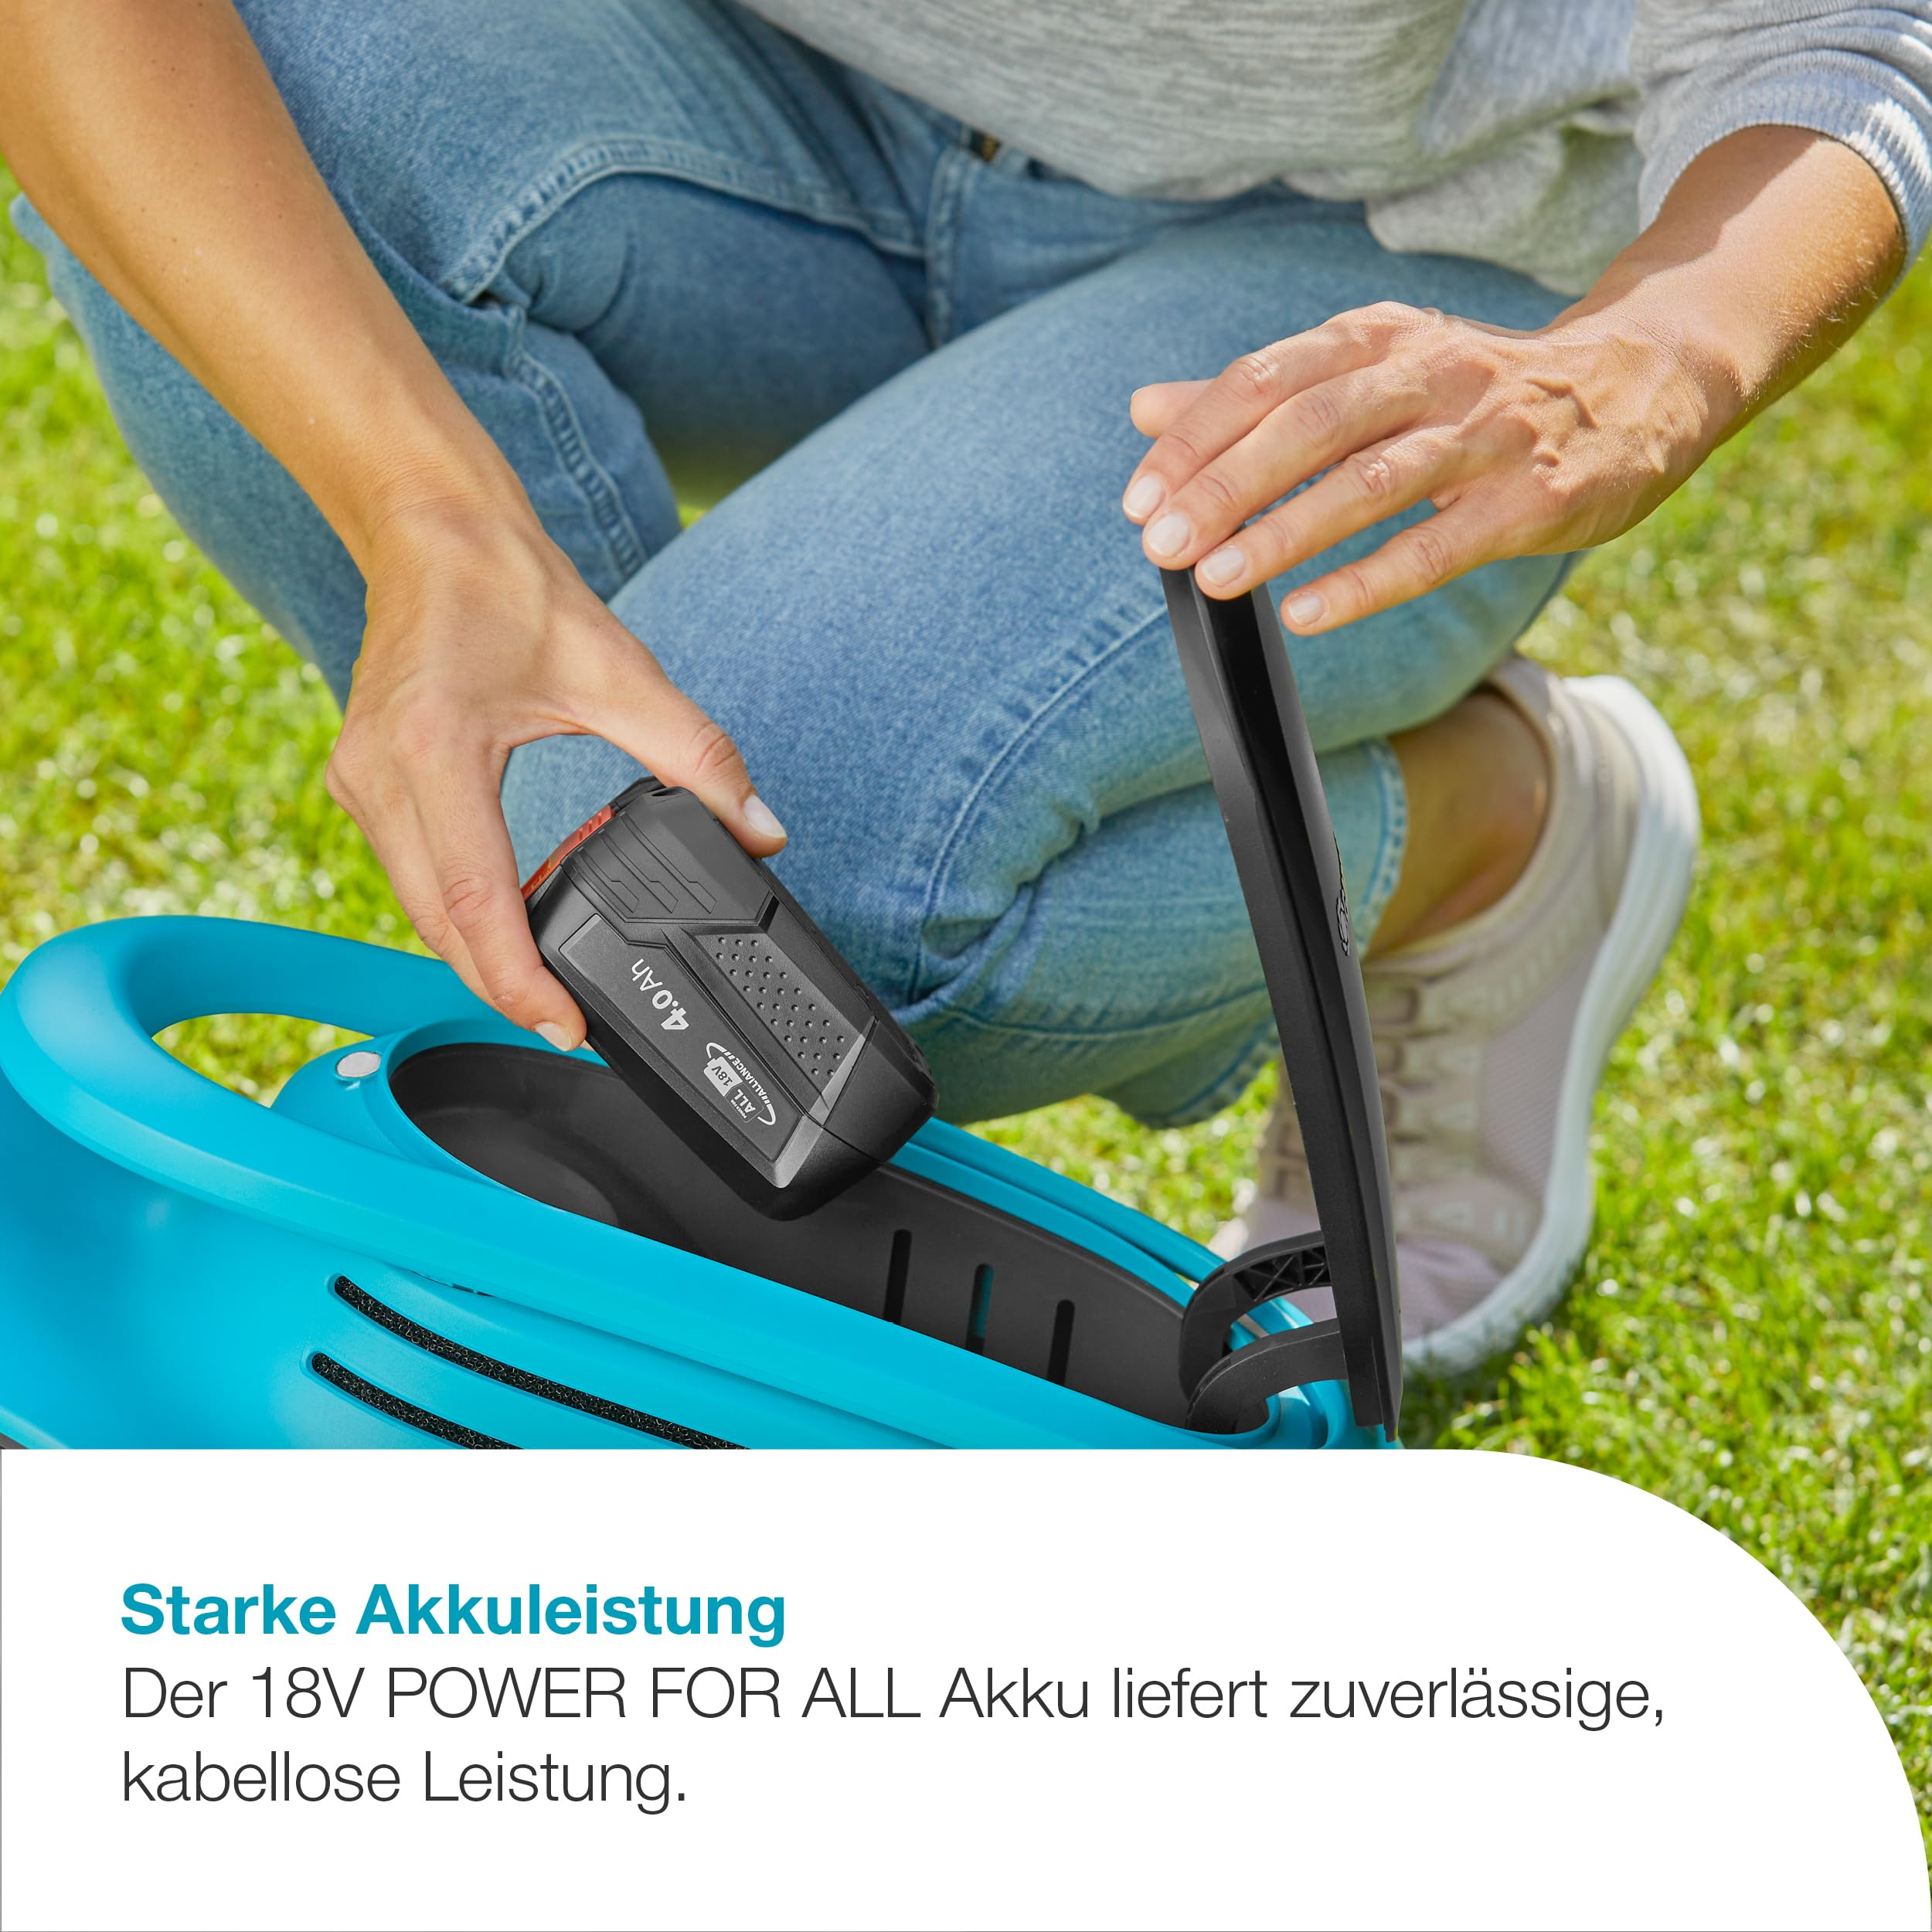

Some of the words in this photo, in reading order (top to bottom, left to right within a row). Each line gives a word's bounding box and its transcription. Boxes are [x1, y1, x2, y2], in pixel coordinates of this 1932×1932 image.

[712, 1066, 733, 1087] 18V
[732, 1058, 767, 1097] ALLIANCE
[734, 1089, 756, 1113] ALL
[736, 1105, 747, 1118] POWER
